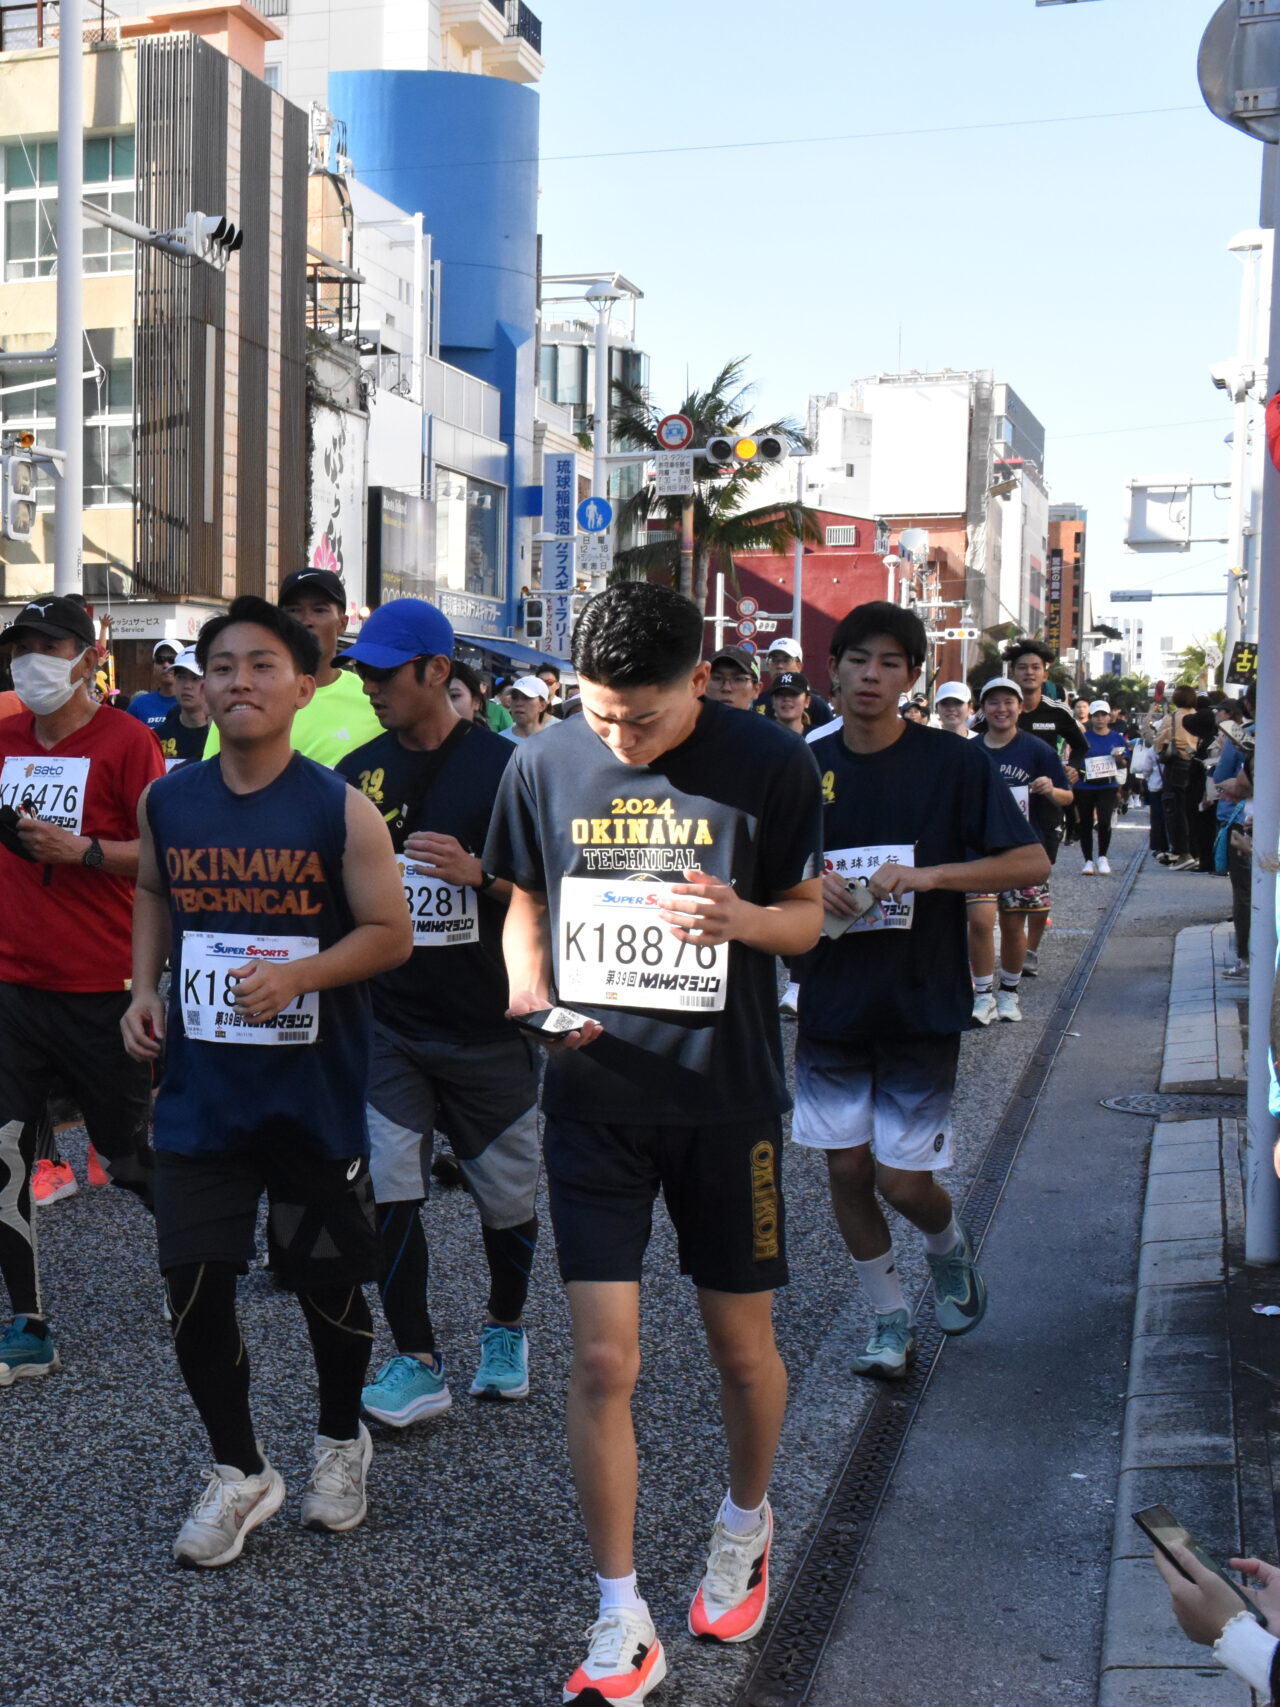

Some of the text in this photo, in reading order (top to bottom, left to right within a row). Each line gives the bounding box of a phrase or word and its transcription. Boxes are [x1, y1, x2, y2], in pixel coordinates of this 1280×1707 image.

[1048, 603, 1061, 652] ドンキホ
[781, 674, 793, 683] NY
[33, 765, 64, 776] sato
[822, 770, 835, 792] 9
[999, 763, 1031, 783] PAINT
[611, 797, 675, 821] 2024
[571, 818, 714, 845] OKINAWA
[166, 847, 327, 883] OKINAWA
[583, 848, 701, 872] TECHNICAL
[170, 886, 324, 916] TECHNICAL
